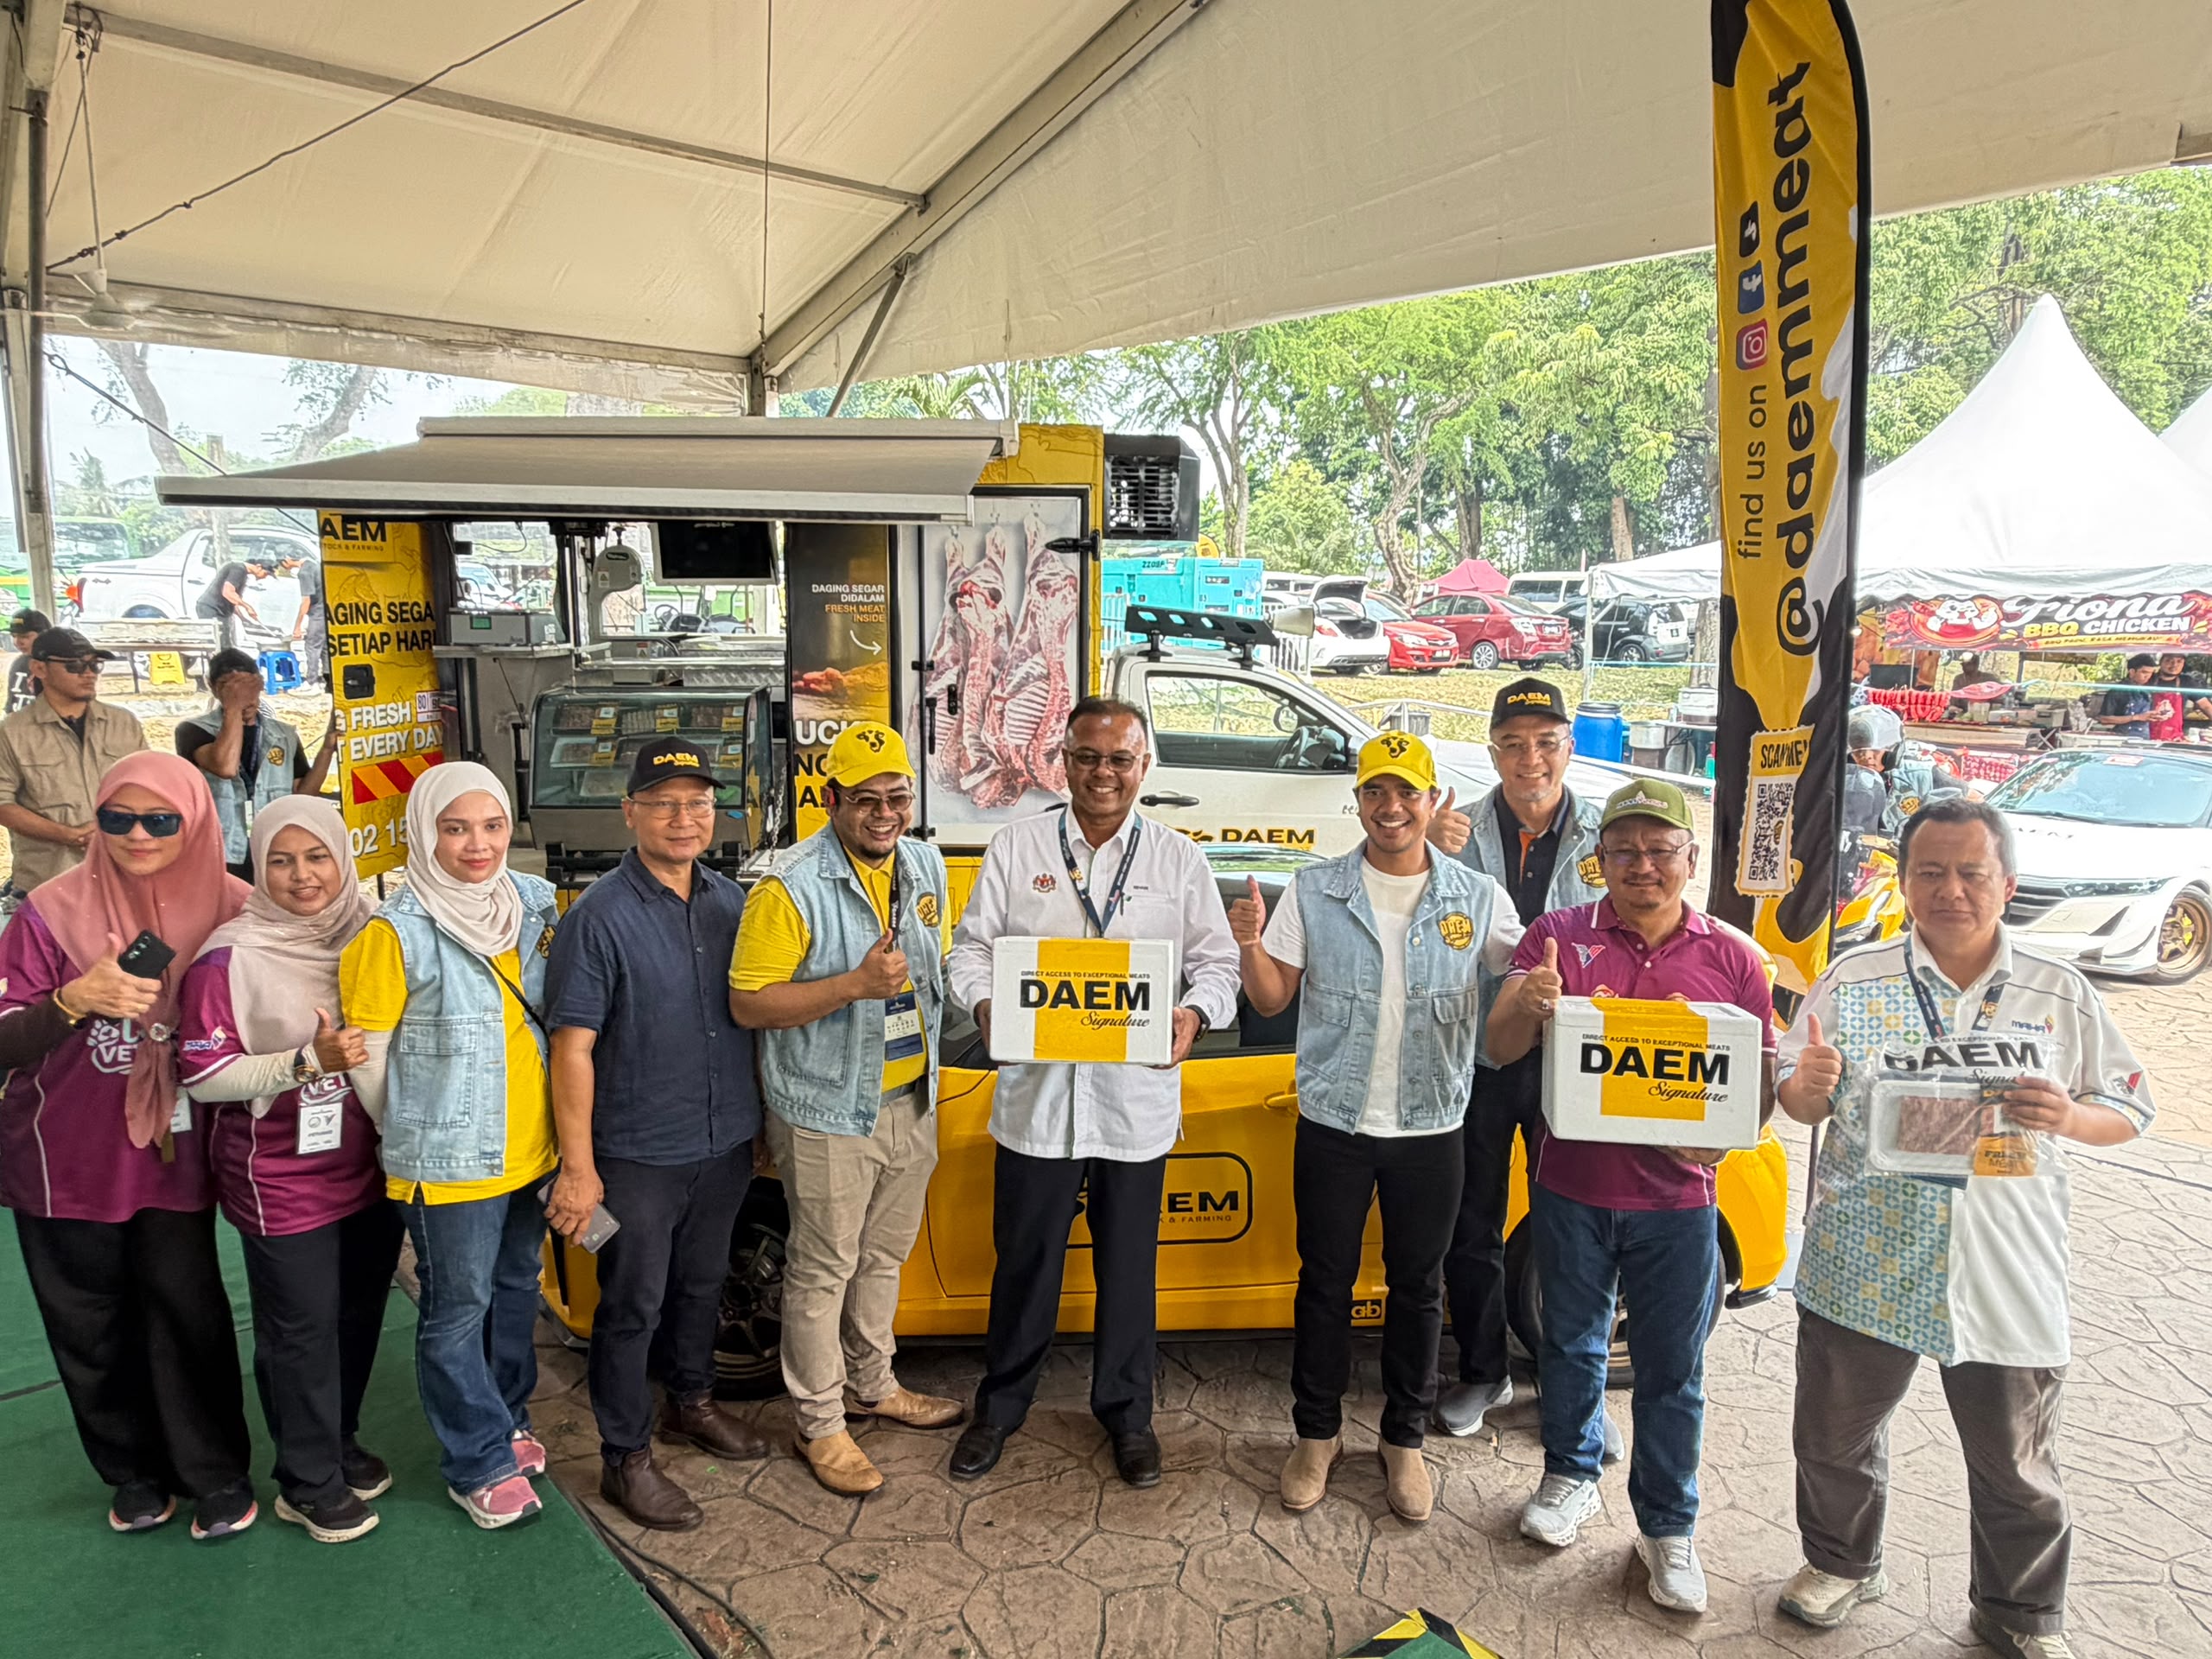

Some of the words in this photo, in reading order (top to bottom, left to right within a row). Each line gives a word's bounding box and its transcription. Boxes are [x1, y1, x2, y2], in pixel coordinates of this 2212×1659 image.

[1767, 61, 1825, 656] @daemmeat
[1748, 385, 1768, 428] on
[1746, 440, 1766, 480] us
[1738, 493, 1764, 559] find
[811, 584, 849, 594] DAGING
[851, 584, 885, 594] SEGAR
[841, 594, 885, 603] DIDALAM
[825, 604, 856, 613] FRESH
[859, 604, 885, 613] MEAT
[853, 613, 885, 623] INSIDE
[2023, 620, 2080, 638] BBQ
[2082, 616, 2192, 634] CHICKEN
[327, 632, 391, 657] SETIAP
[1507, 692, 1551, 704] DAEM
[351, 701, 412, 731] FRESH
[351, 731, 410, 761] EVERY
[653, 753, 698, 765] DAEM
[1221, 829, 1315, 844] DAEM
[1020, 979, 1150, 1011] DAEM
[1080, 1011, 1150, 1030] Signature
[1653, 1039, 1703, 1049] EXCEPTIONAL
[1580, 1042, 1730, 1085] DAEM
[1649, 1082, 1729, 1103] Signature
[1160, 1191, 1239, 1213] EM
